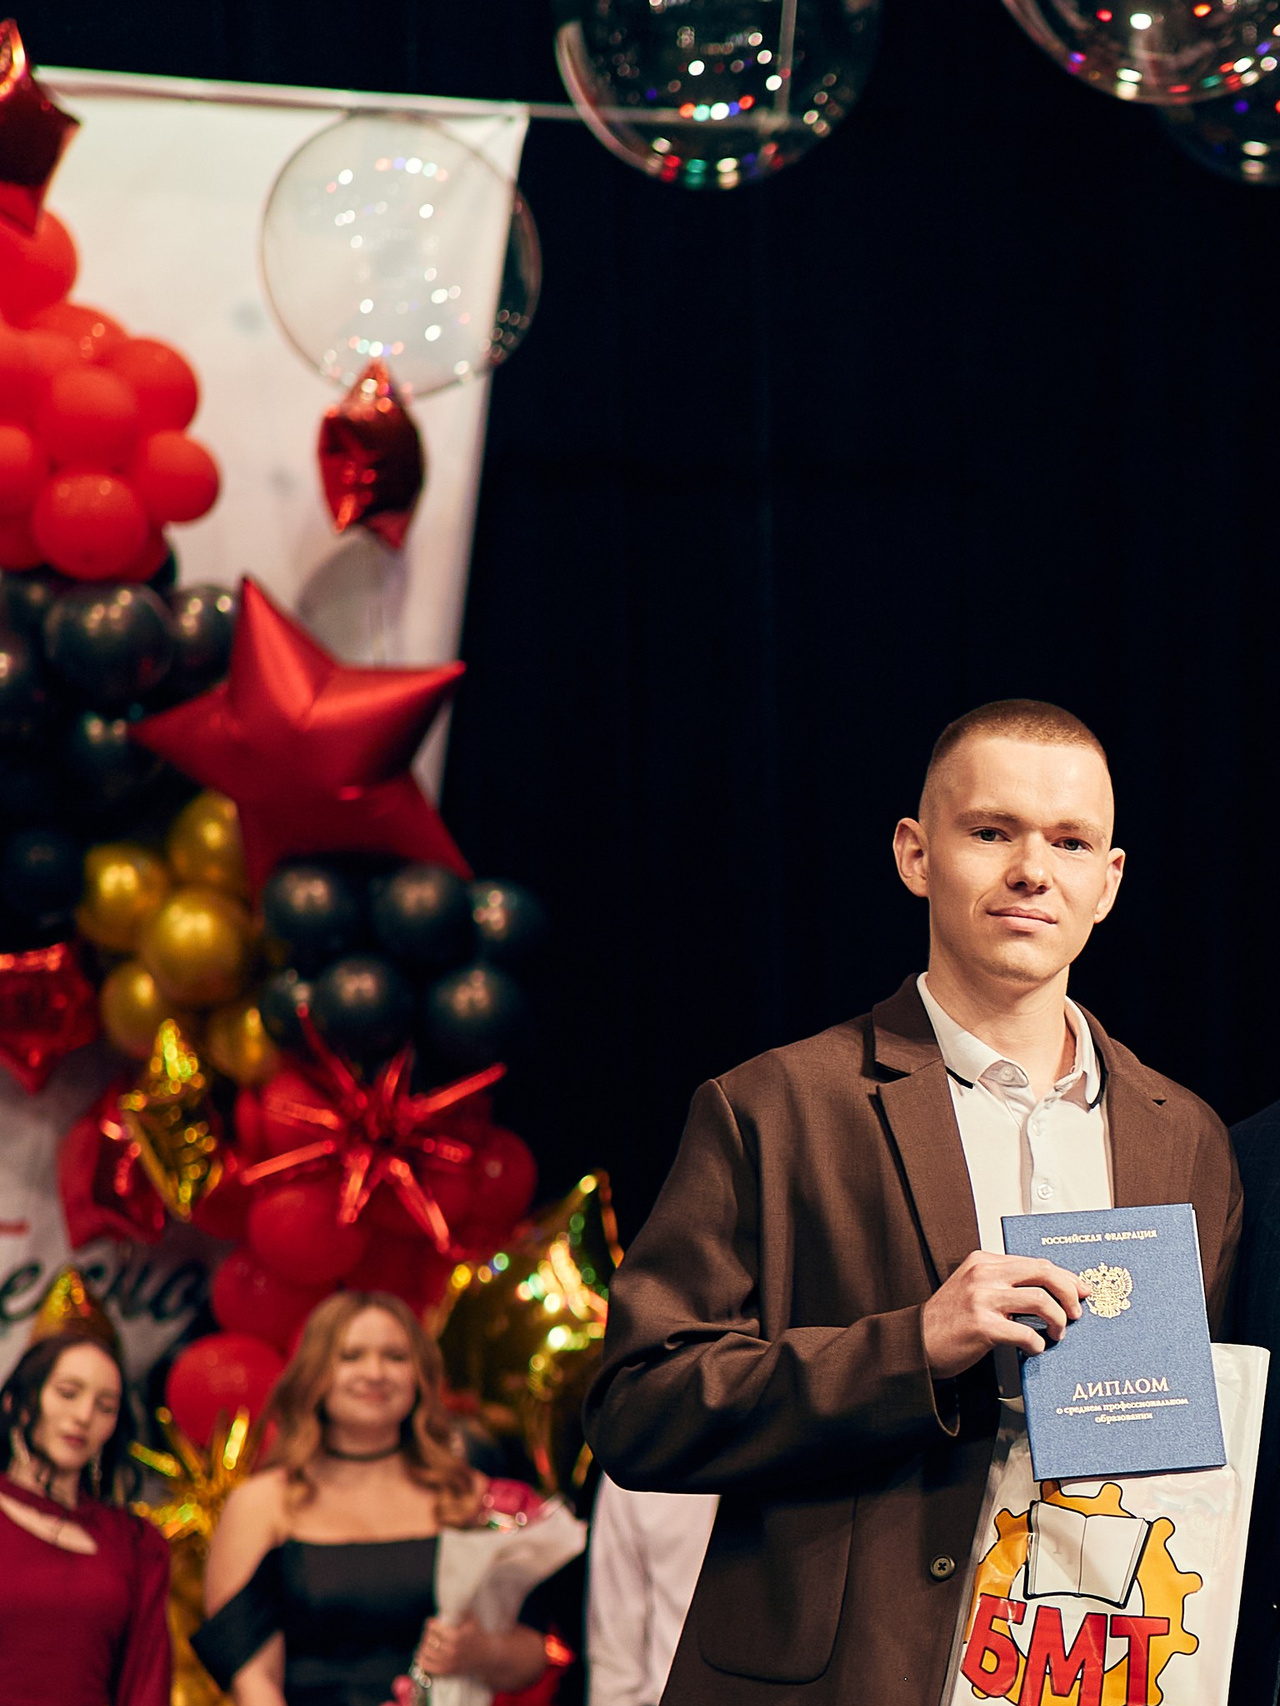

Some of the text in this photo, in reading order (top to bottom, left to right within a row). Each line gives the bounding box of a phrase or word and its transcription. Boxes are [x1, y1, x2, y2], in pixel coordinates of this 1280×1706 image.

[1041, 1230, 1157, 1245] РОССИЙСКАЯ ФЕДЕРАЦИЯ
[1072, 1377, 1169, 1401] ДИПЛОМ
[1064, 1405, 1102, 1415] среднем
[1103, 1398, 1189, 1412] профессиональном
[1095, 1412, 1153, 1424] образовании
